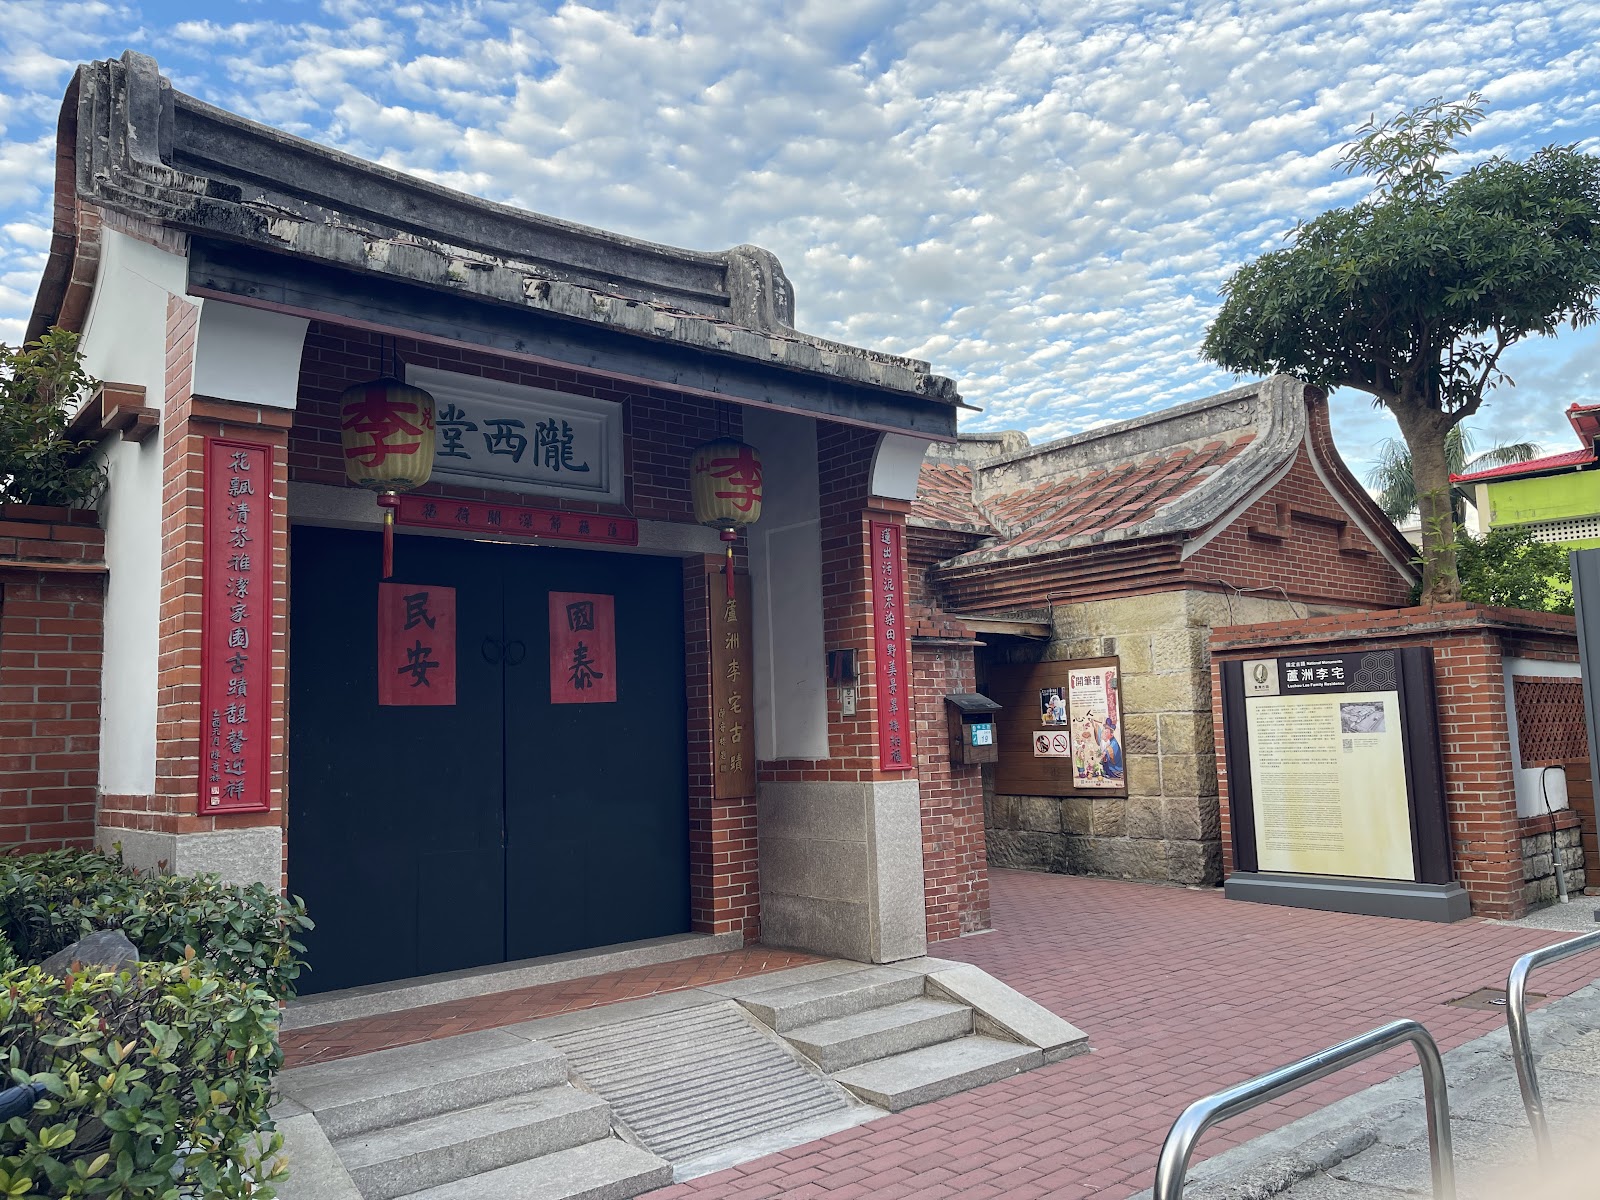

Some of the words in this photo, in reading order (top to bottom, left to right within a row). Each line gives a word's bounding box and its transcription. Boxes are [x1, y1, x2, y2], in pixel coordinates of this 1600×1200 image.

[342, 386, 424, 467] 李
[710, 447, 762, 512] 李
[398, 592, 440, 688] 民安
[565, 601, 604, 690] 國泰
[1286, 667, 1345, 682] 蘆洲李宅
[724, 599, 743, 773] 蘆洲李宅古蹟
